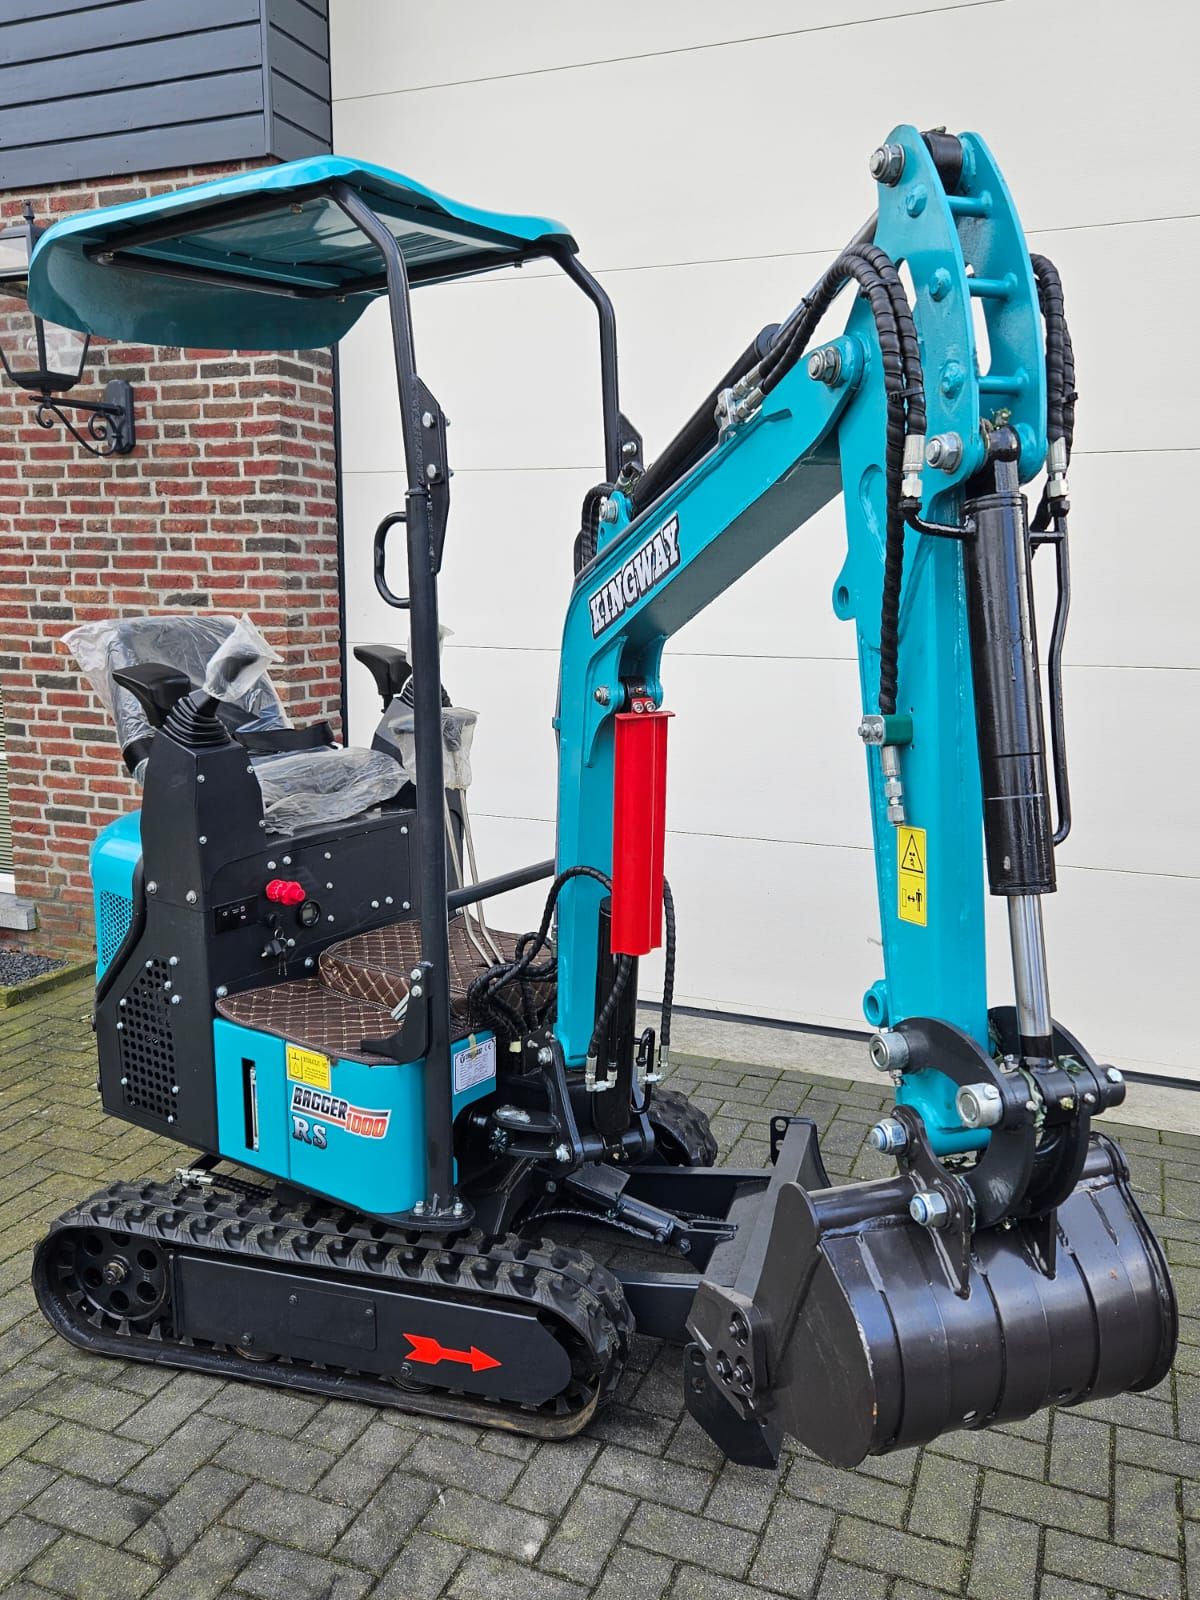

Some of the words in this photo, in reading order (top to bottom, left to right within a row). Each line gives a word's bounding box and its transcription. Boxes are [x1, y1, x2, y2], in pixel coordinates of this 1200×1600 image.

[589, 513, 680, 636] KINGWAY
[292, 1115, 328, 1150] RS
[293, 1086, 348, 1121] BAGGER
[345, 1112, 388, 1138] 1000
